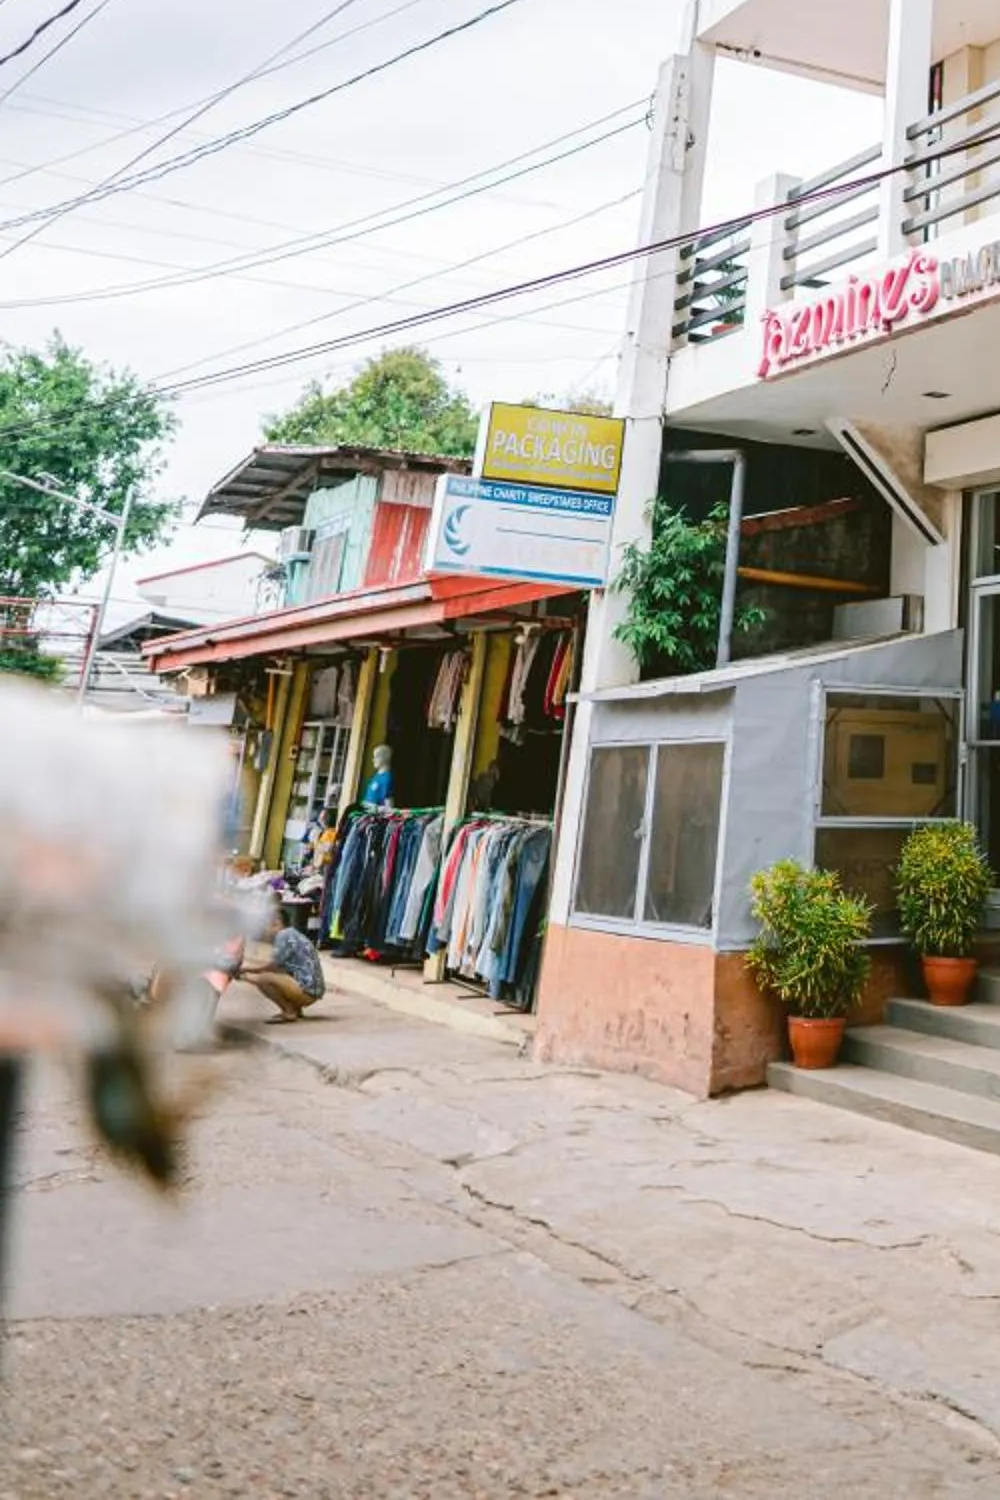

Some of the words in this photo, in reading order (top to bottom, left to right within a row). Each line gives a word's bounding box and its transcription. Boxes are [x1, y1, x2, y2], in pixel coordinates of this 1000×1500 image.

[491, 428, 616, 470] PACKAGING
[493, 486, 527, 502] CHARITY
[527, 490, 583, 509] SWEEPSTAKES
[583, 499, 610, 514] OFFICE
